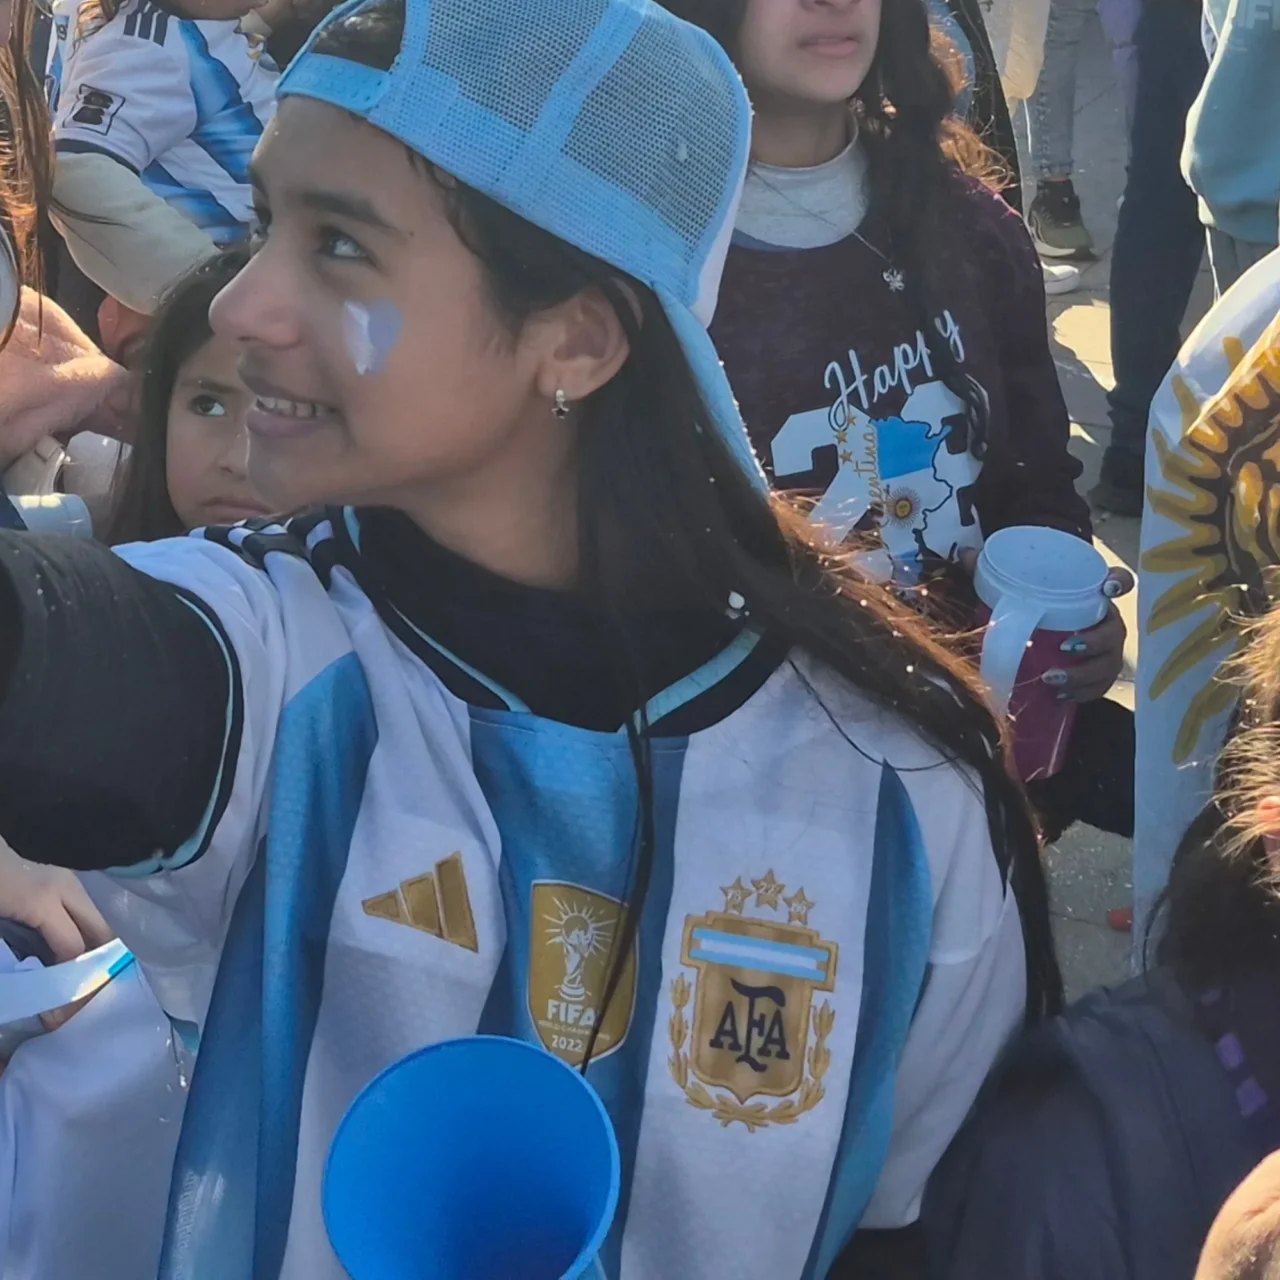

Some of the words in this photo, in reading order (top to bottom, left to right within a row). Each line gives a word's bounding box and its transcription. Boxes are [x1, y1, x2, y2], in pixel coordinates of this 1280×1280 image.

[546, 999, 597, 1027] FIFA
[708, 977, 791, 1073] AFA
[551, 1034, 585, 1054] 2022
